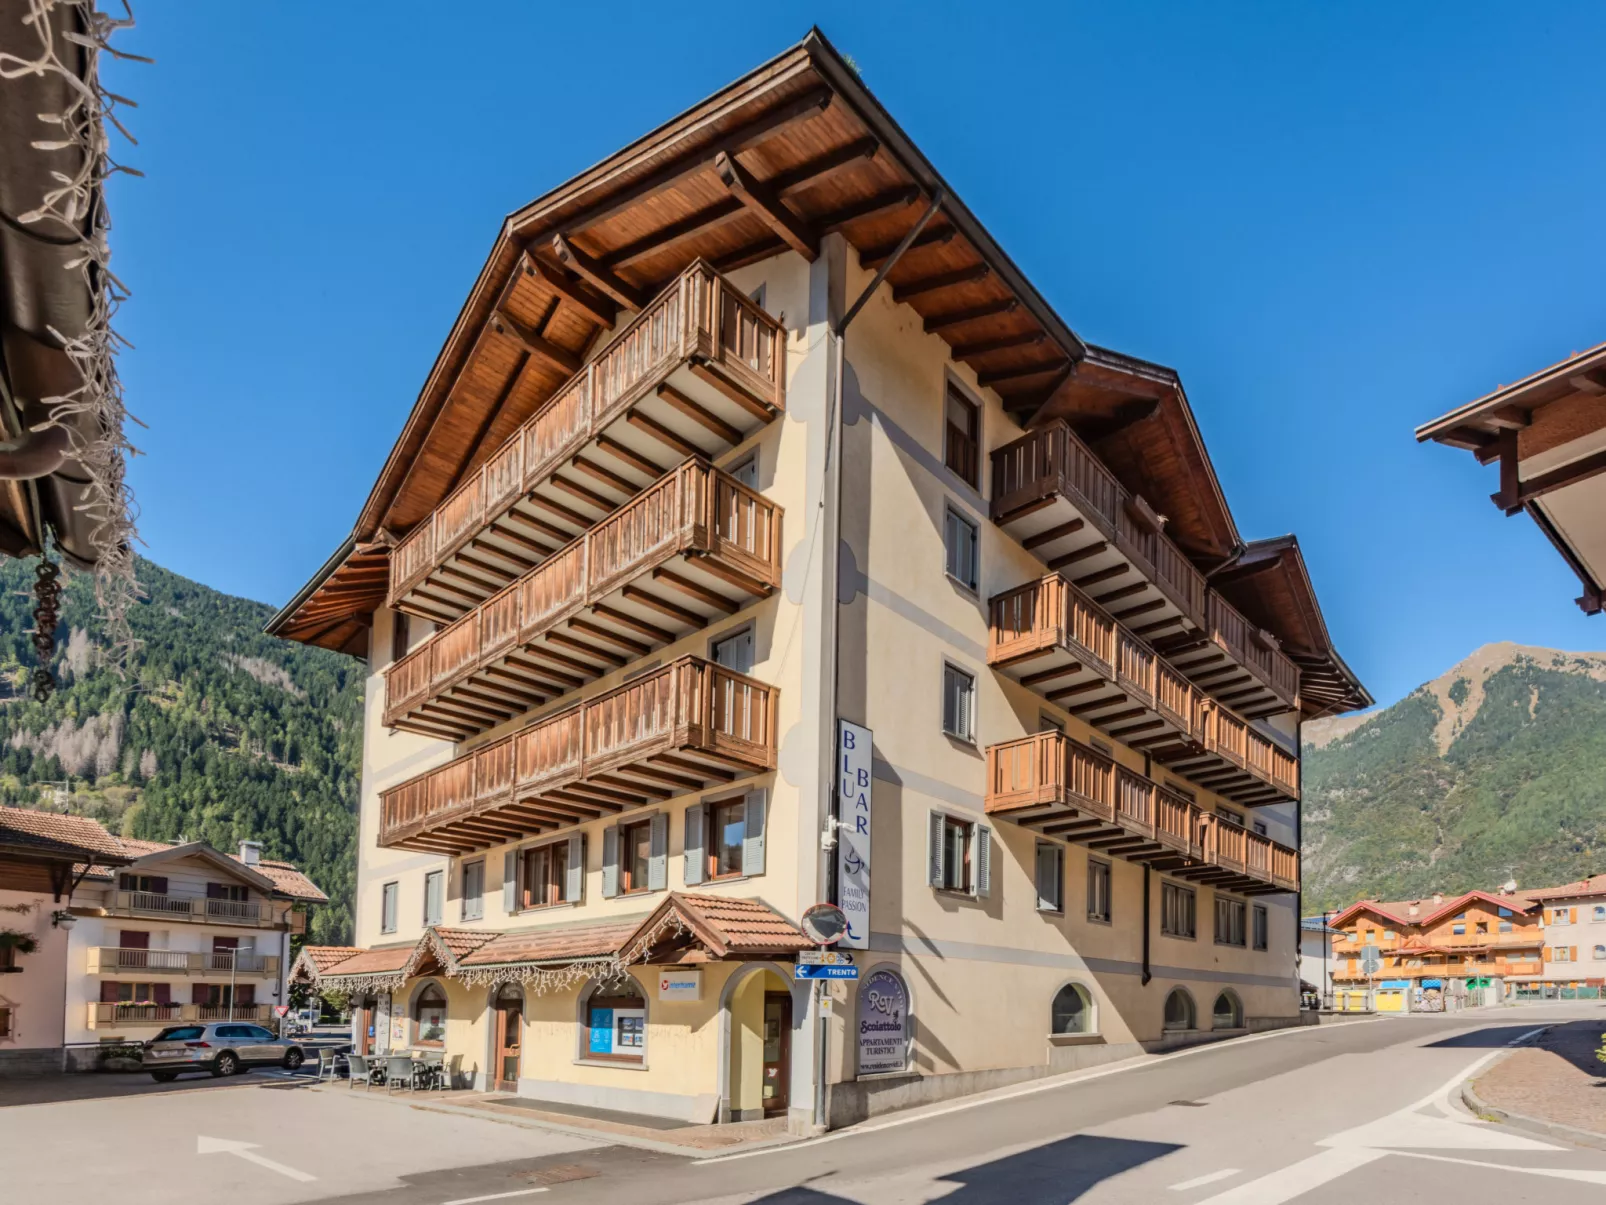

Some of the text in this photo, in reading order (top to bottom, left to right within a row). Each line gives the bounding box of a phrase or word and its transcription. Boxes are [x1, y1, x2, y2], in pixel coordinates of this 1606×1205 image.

[843, 729, 855, 798] BLU
[856, 768, 869, 835] BAR
[843, 886, 864, 899] FAMILY
[841, 899, 866, 912] PASSION
[827, 968, 857, 976] TRENTO
[860, 1020, 902, 1034] Scoiattolo
[866, 1047, 895, 1055] TURISTICI
